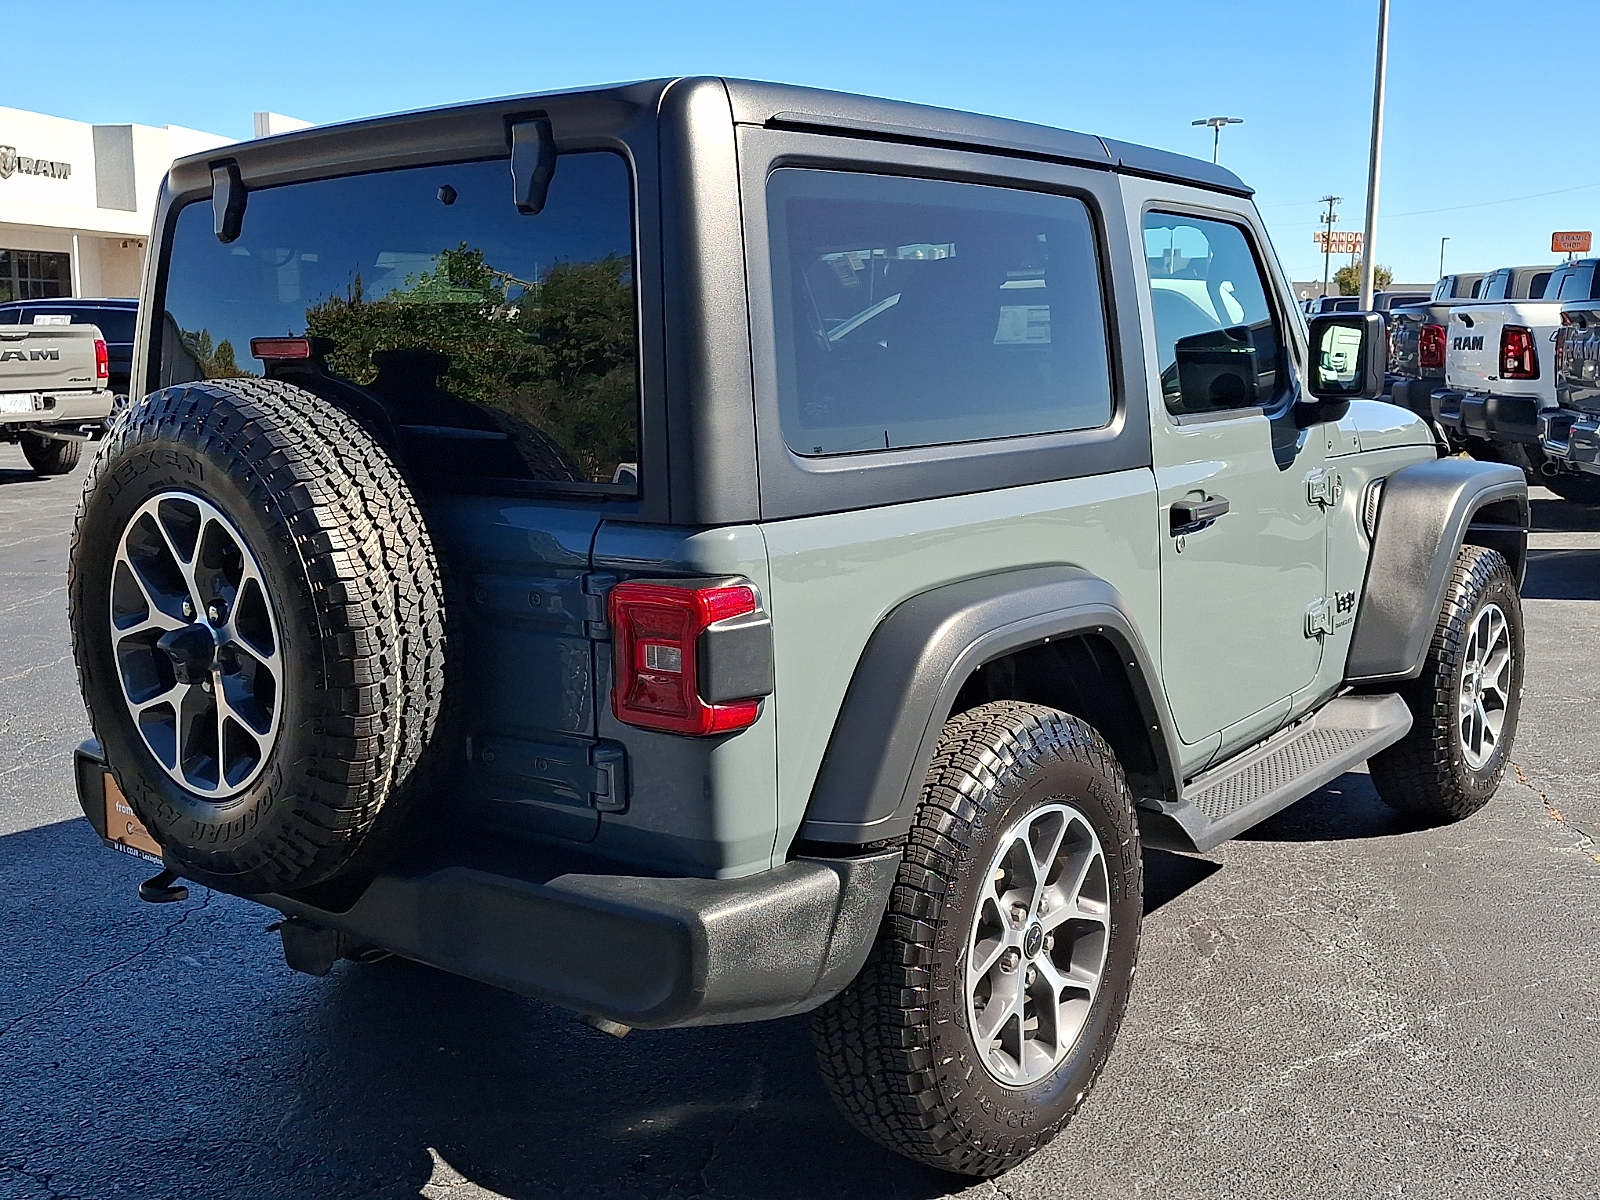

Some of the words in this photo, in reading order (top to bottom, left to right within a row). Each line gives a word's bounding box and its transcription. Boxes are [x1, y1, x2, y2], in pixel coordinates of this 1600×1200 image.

[18, 156, 71, 179] RAM
[1322, 243, 1361, 253] PANDA
[1453, 336, 1484, 350] RAM
[107, 448, 205, 506] NEXEN
[115, 800, 135, 816] from
